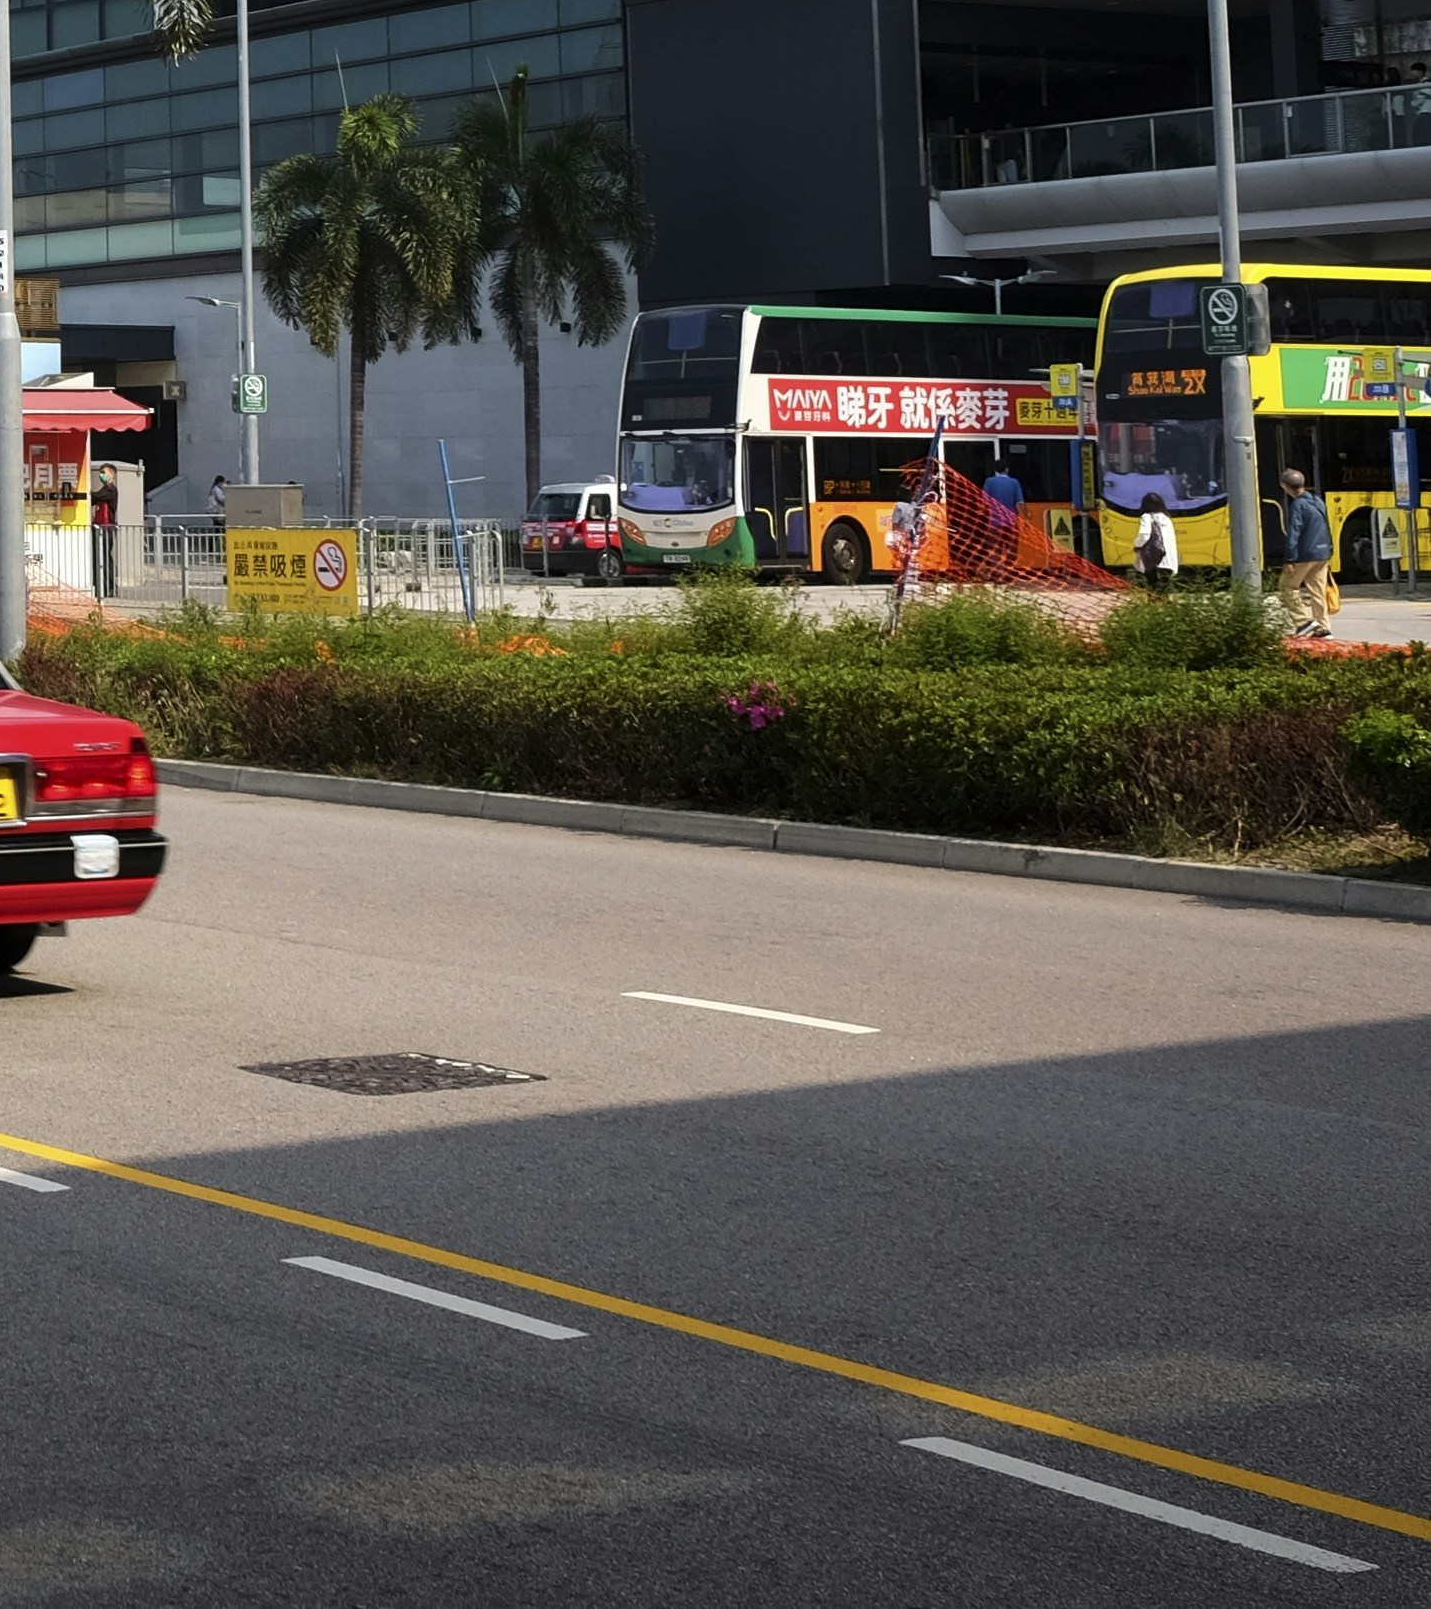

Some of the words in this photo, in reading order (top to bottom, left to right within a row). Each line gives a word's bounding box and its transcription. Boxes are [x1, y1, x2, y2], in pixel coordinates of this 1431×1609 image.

[1183, 377, 1206, 394] 2X
[773, 389, 832, 409] MAIYA
[836, 386, 894, 428] 睇牙
[899, 386, 1010, 430] 就係麥芽
[234, 553, 307, 578] 嚴禁吸煙
